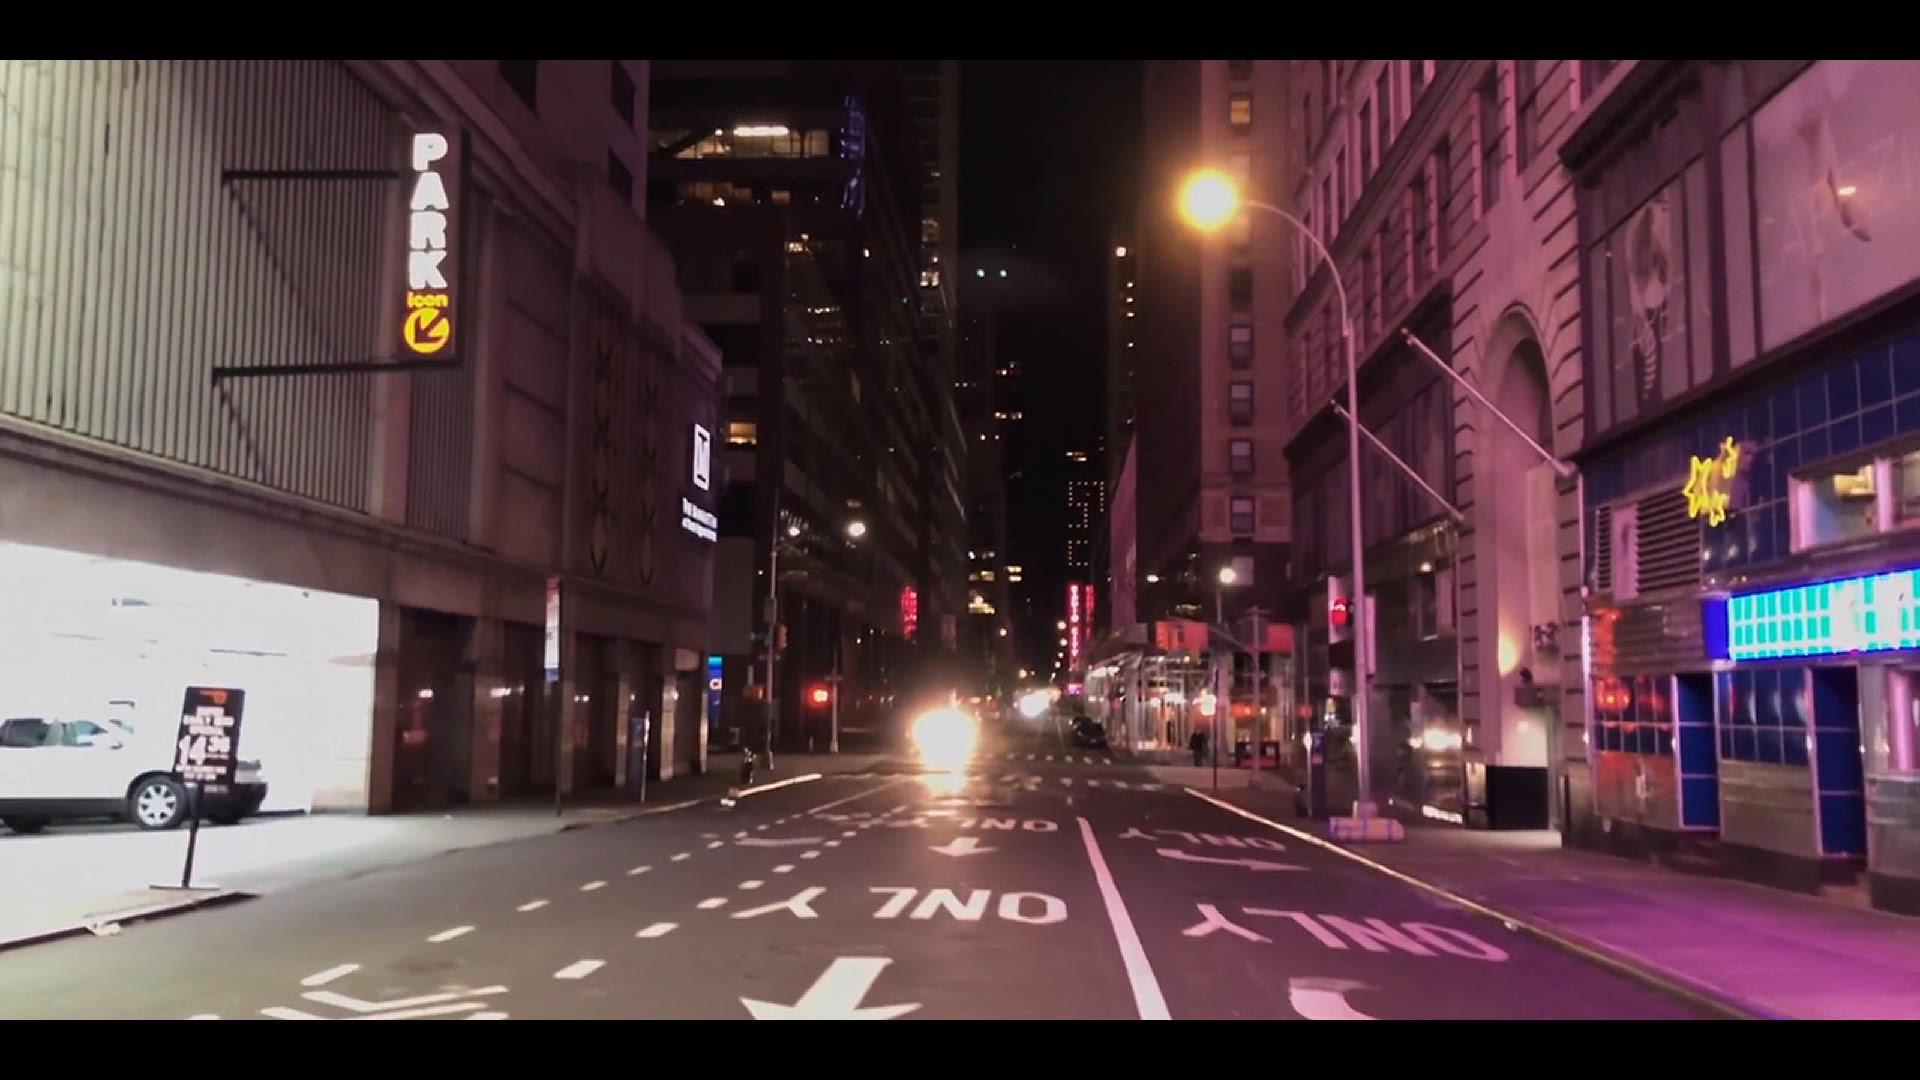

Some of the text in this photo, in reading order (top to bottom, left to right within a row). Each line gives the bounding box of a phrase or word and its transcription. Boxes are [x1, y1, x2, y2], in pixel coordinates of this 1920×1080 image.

[409, 133, 450, 290] PARK
[407, 292, 449, 308] icon
[1118, 827, 1286, 851] ONLY
[730, 886, 1068, 924] ONLY
[1181, 903, 1509, 962] ONLY
